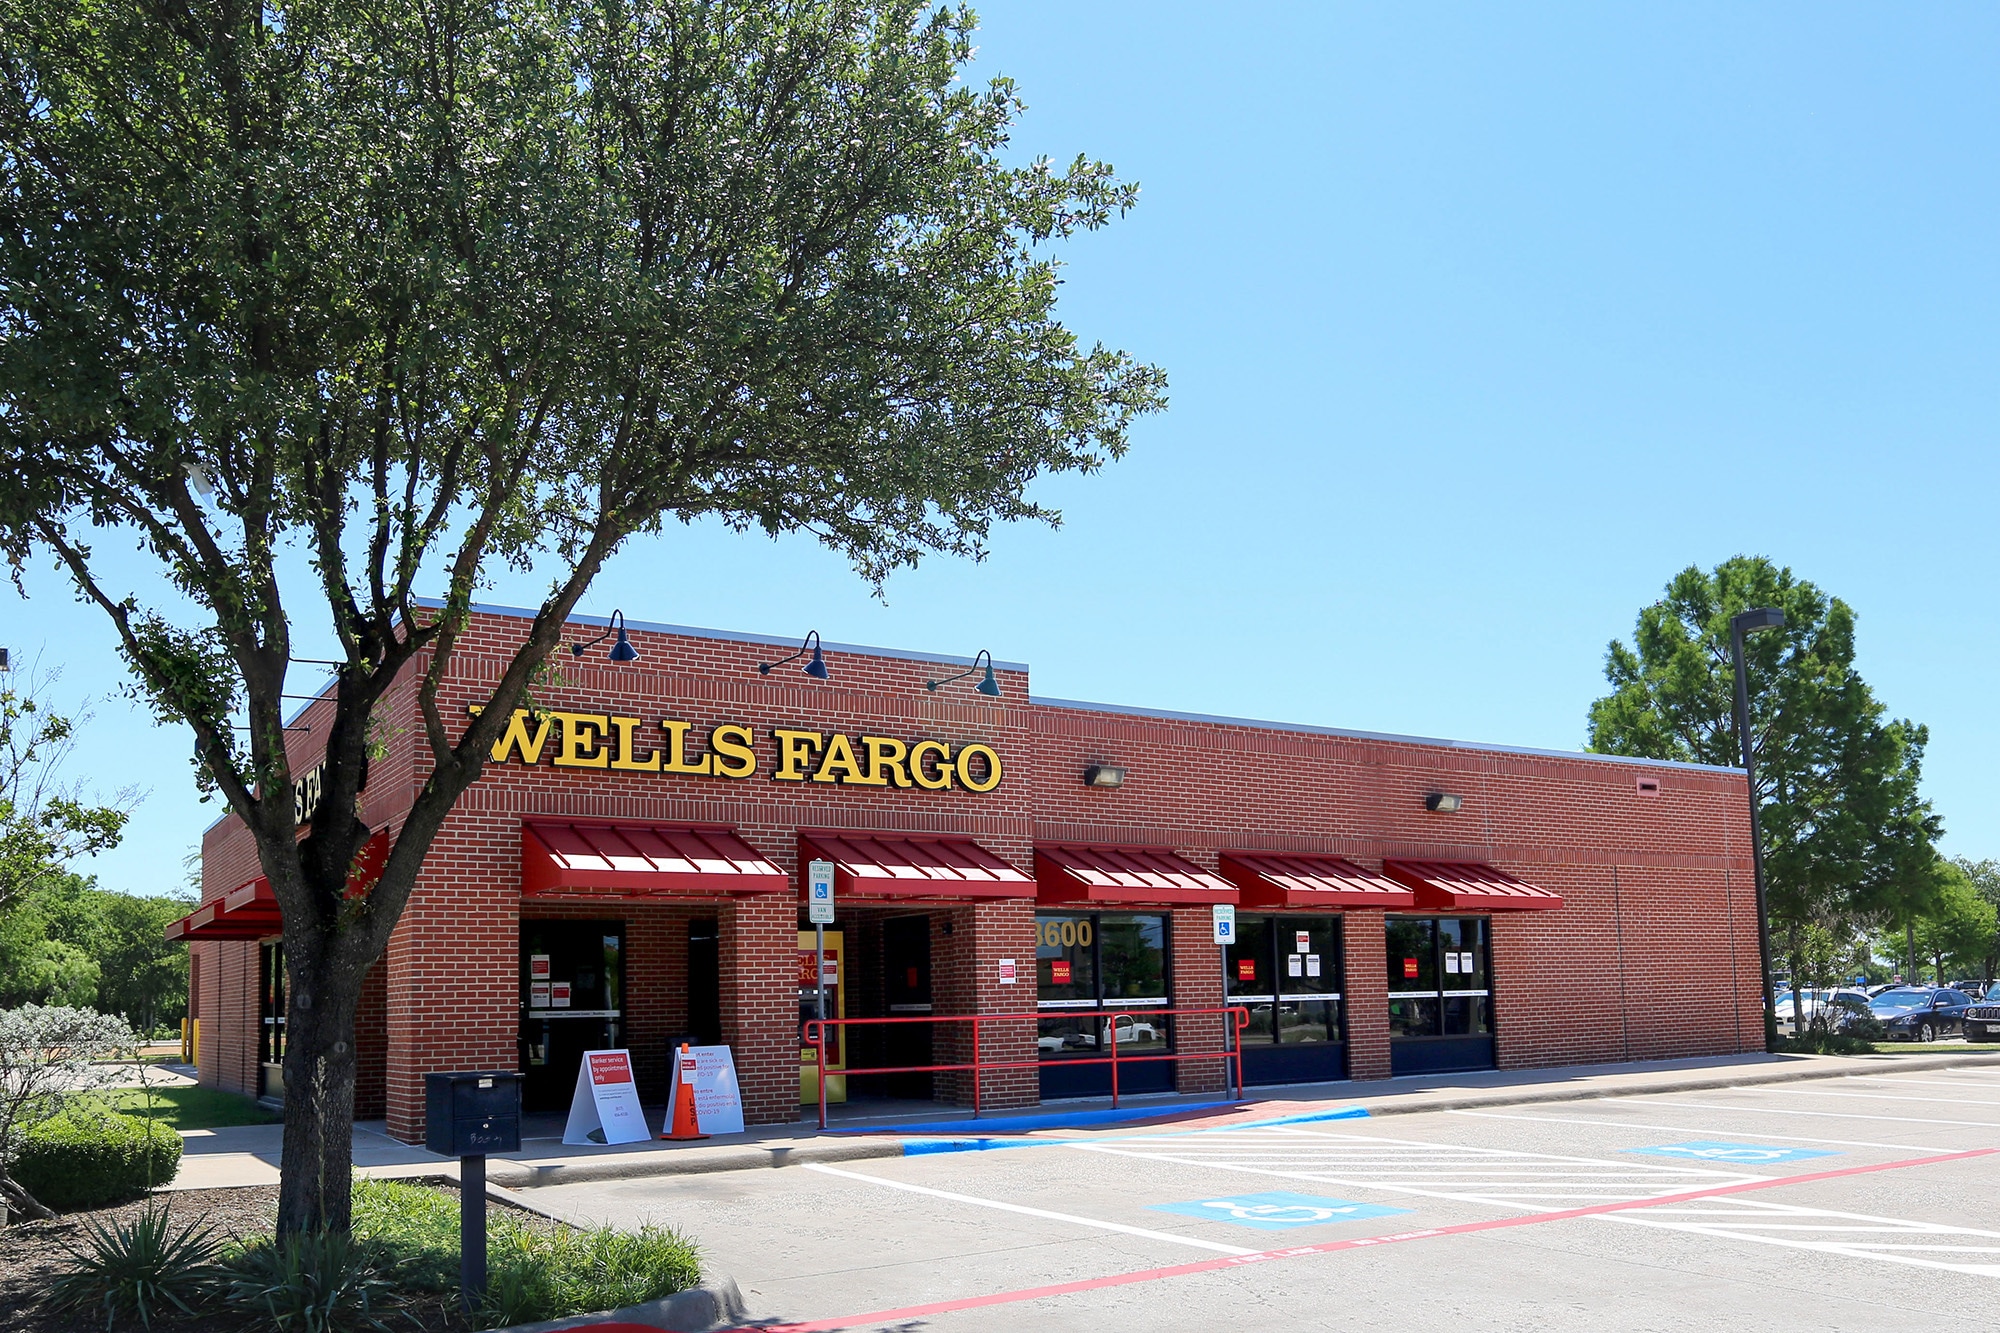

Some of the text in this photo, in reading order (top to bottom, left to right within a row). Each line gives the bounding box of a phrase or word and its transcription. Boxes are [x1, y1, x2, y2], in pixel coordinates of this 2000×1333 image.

[469, 705, 1003, 793] WELLS FARGO
[600, 1065, 629, 1073] appointment
[595, 1074, 605, 1082] only
[1273, 1247, 1324, 1257] LANE
